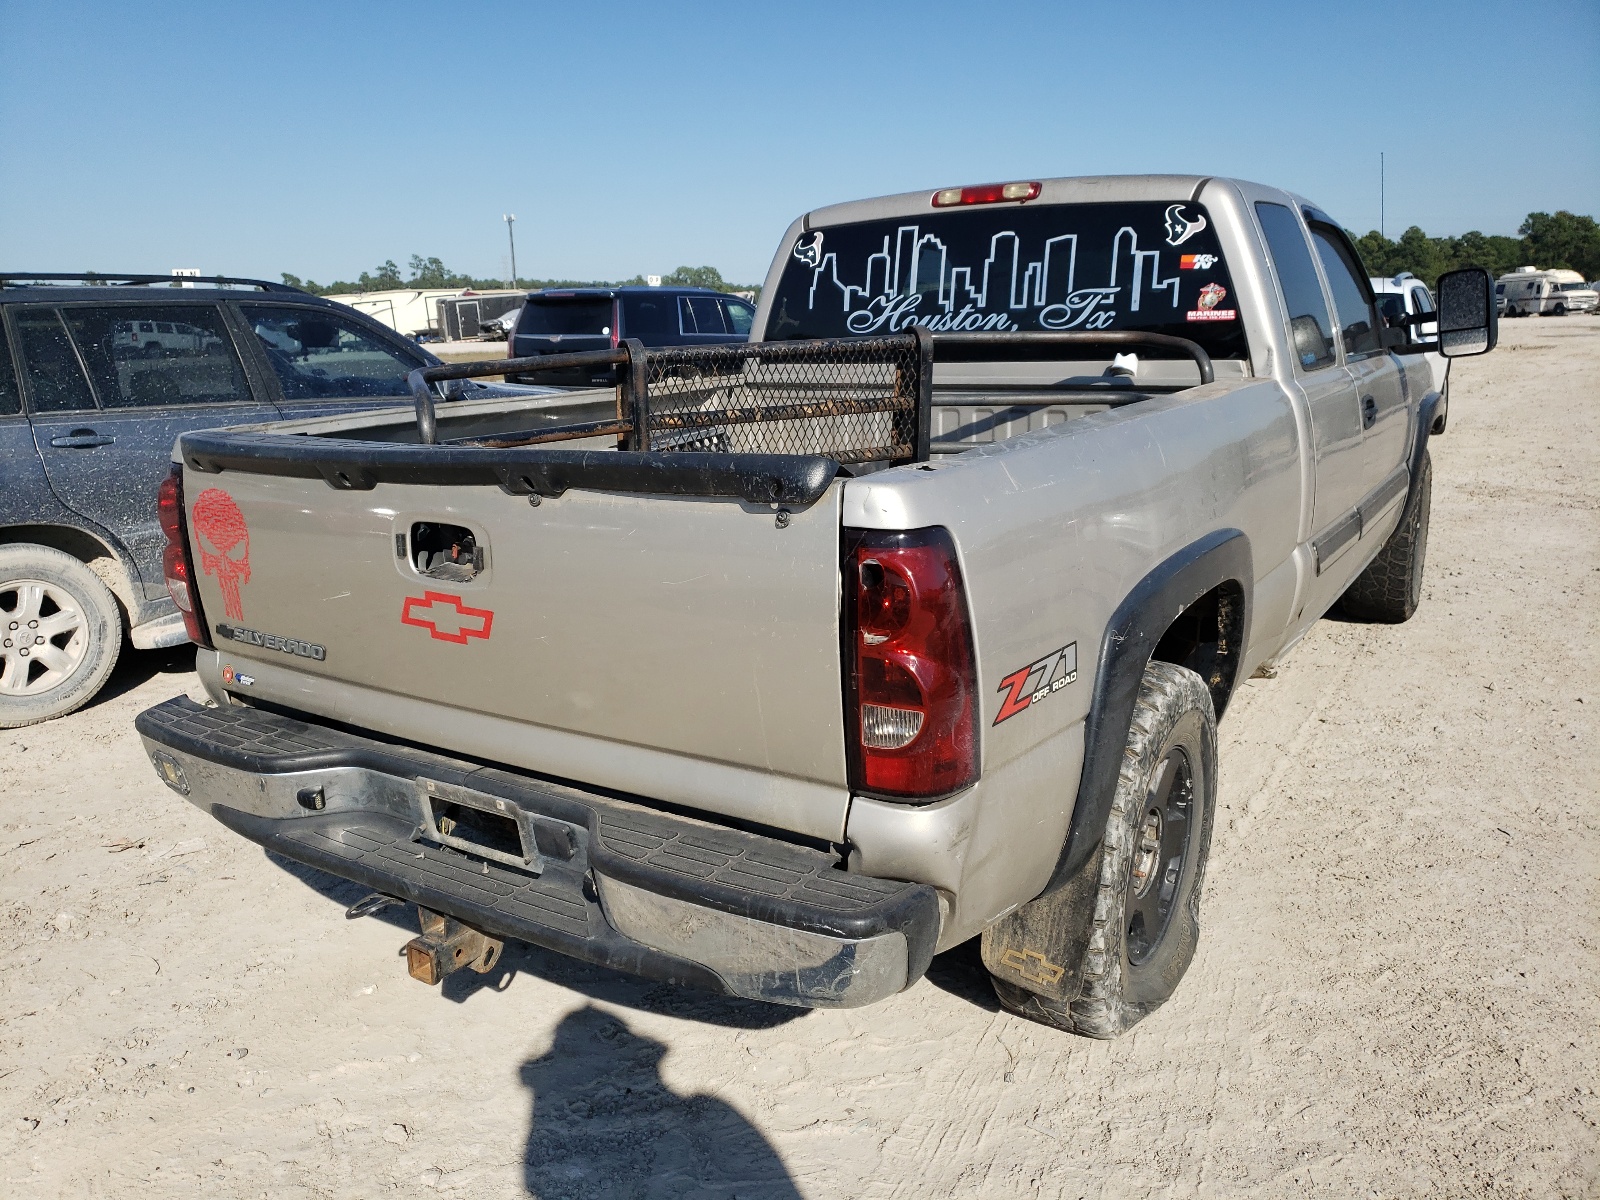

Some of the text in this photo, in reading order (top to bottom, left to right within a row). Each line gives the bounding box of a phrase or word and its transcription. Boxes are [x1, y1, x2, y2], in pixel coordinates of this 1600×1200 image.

[847, 286, 1122, 334] Houston, Tx
[233, 627, 326, 661] SILVERADO
[992, 641, 1077, 727] Z71
[1032, 671, 1077, 704] OFF ROAD
